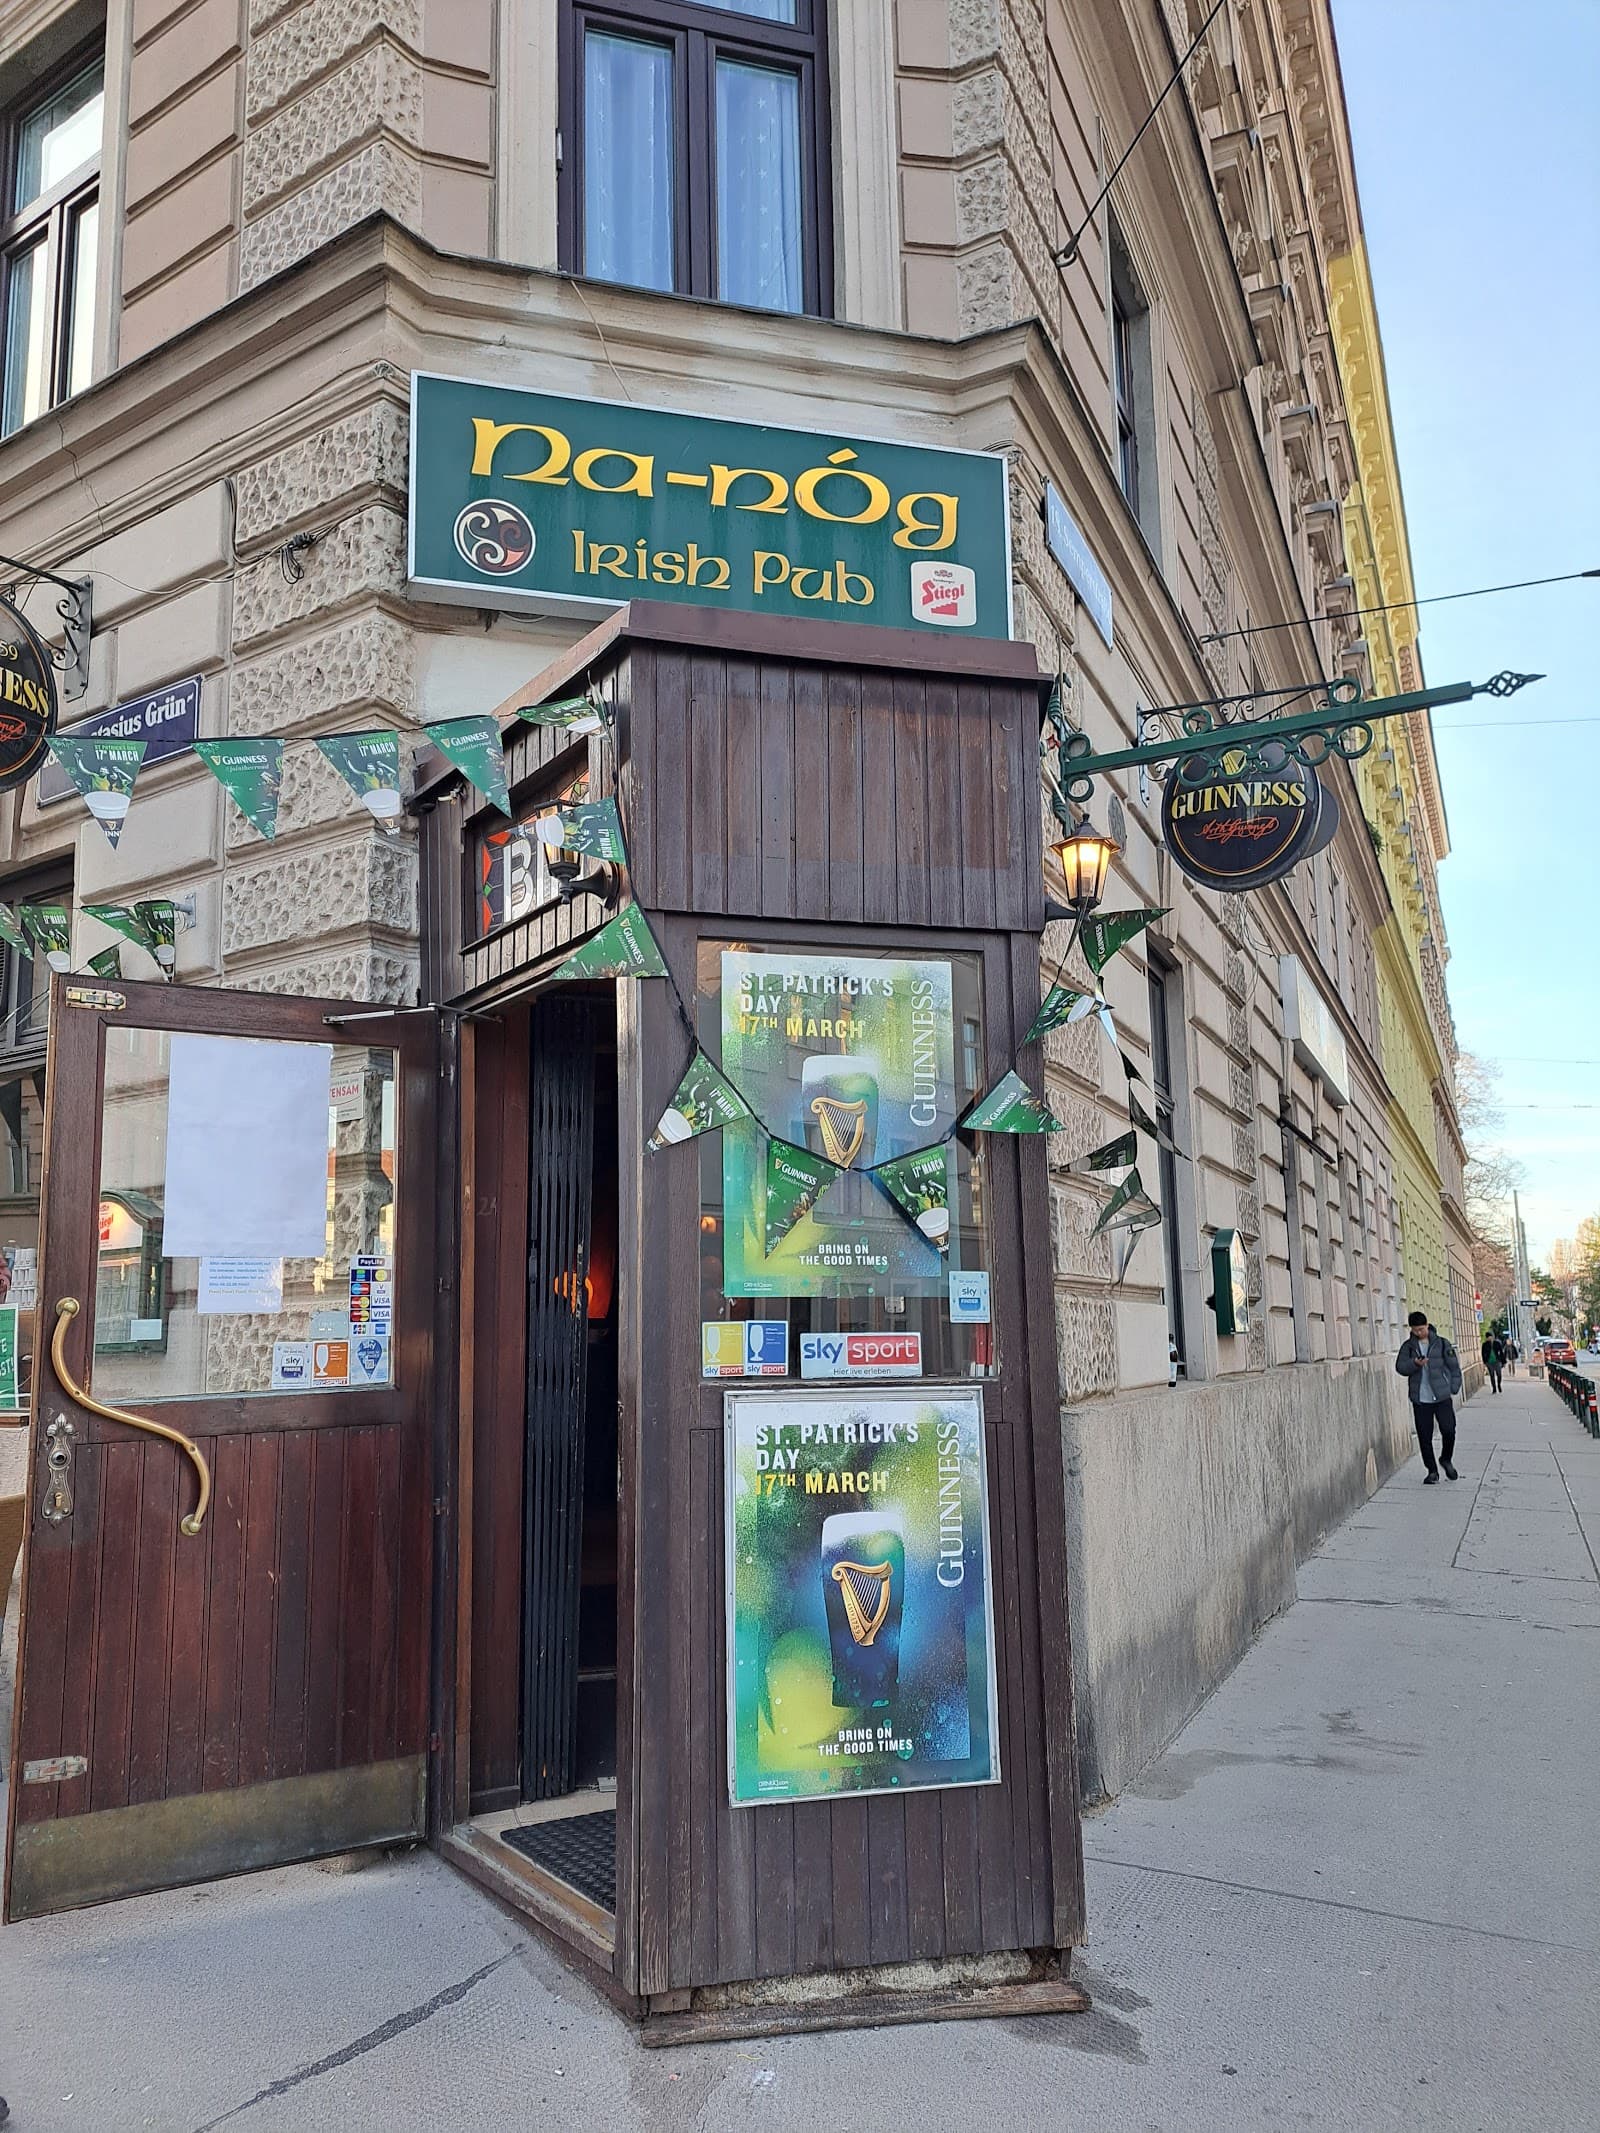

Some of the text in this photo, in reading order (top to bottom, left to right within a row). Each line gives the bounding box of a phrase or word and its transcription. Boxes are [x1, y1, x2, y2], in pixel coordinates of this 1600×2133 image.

[572, 530, 876, 606] Irish Pub
[922, 579, 965, 606] Stiegl
[369, 741, 396, 755] MARCH
[450, 731, 489, 747] GUINNESS
[109, 750, 139, 762] MARCH
[222, 754, 268, 766] GUINNESS
[1171, 781, 1308, 821] GUINNESS
[622, 927, 645, 965] GUINNESS
[740, 971, 894, 997] ST. PATRICK'S
[740, 994, 782, 1014] DAY
[739, 1015, 863, 1038] 17TH MARCH
[909, 979, 937, 1127] GUINNESS
[715, 1096, 738, 1119] MARCH
[781, 1163, 818, 1186] GUINNESS
[921, 1157, 945, 1175] MARCH
[818, 1244, 869, 1255] BRING ON
[799, 1255, 888, 1266] THE GOOD TIMES
[961, 1286, 977, 1297] sky
[803, 1337, 915, 1363] sky sport
[285, 1356, 300, 1367] sky
[704, 1366, 744, 1375] sky sport
[747, 1365, 785, 1374] sky sport
[849, 1367, 863, 1375] live
[863, 1367, 892, 1375] erleben
[756, 1422, 919, 1446] ST. PATRICK'S
[756, 1449, 800, 1470] DAY
[755, 1471, 887, 1495] 17TH MARCH
[936, 1421, 964, 1588] GUINNESS
[838, 1728, 892, 1742] BRING ON
[818, 1738, 913, 1756] THE GOOD TIMES
